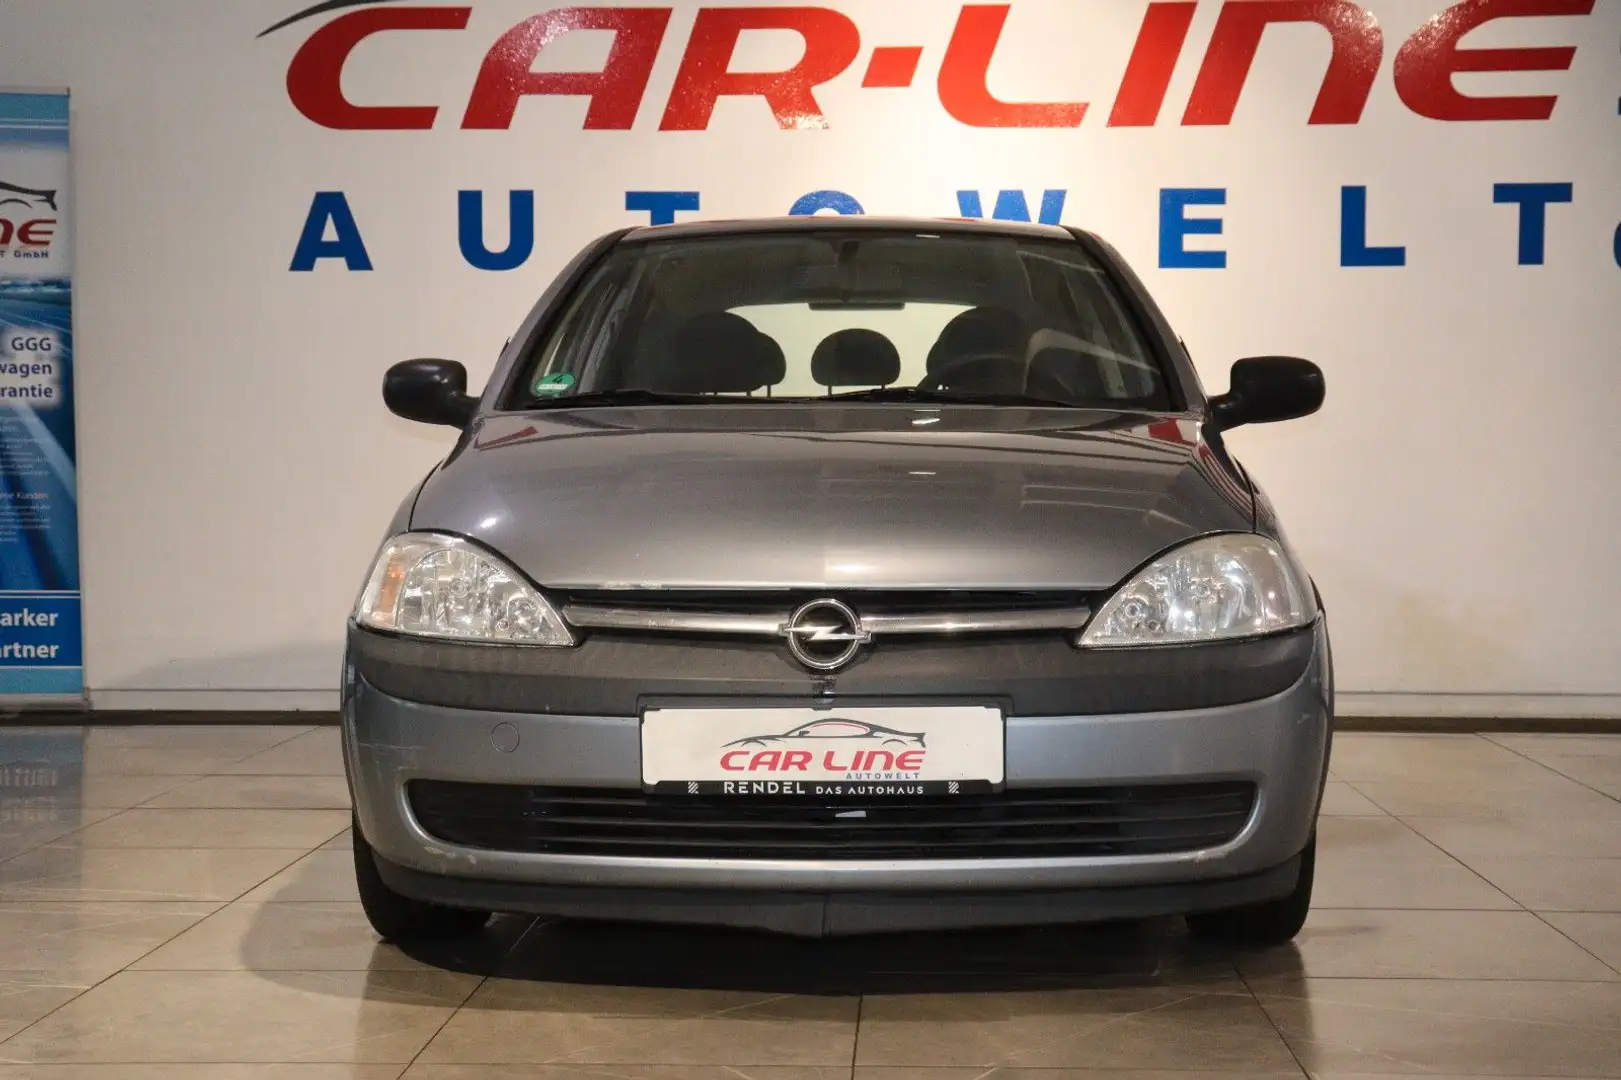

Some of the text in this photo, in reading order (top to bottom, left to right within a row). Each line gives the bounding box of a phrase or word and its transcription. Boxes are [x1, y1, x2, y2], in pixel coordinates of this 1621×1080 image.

[11, 336, 52, 352] GGG
[0, 384, 53, 398] rantie
[0, 607, 59, 627] arker
[0, 641, 60, 659] rtner
[719, 750, 927, 771] CAR LINE
[845, 772, 920, 780] AUTOWELT
[723, 781, 925, 795] RENDEL DAS AUTOHAUS
